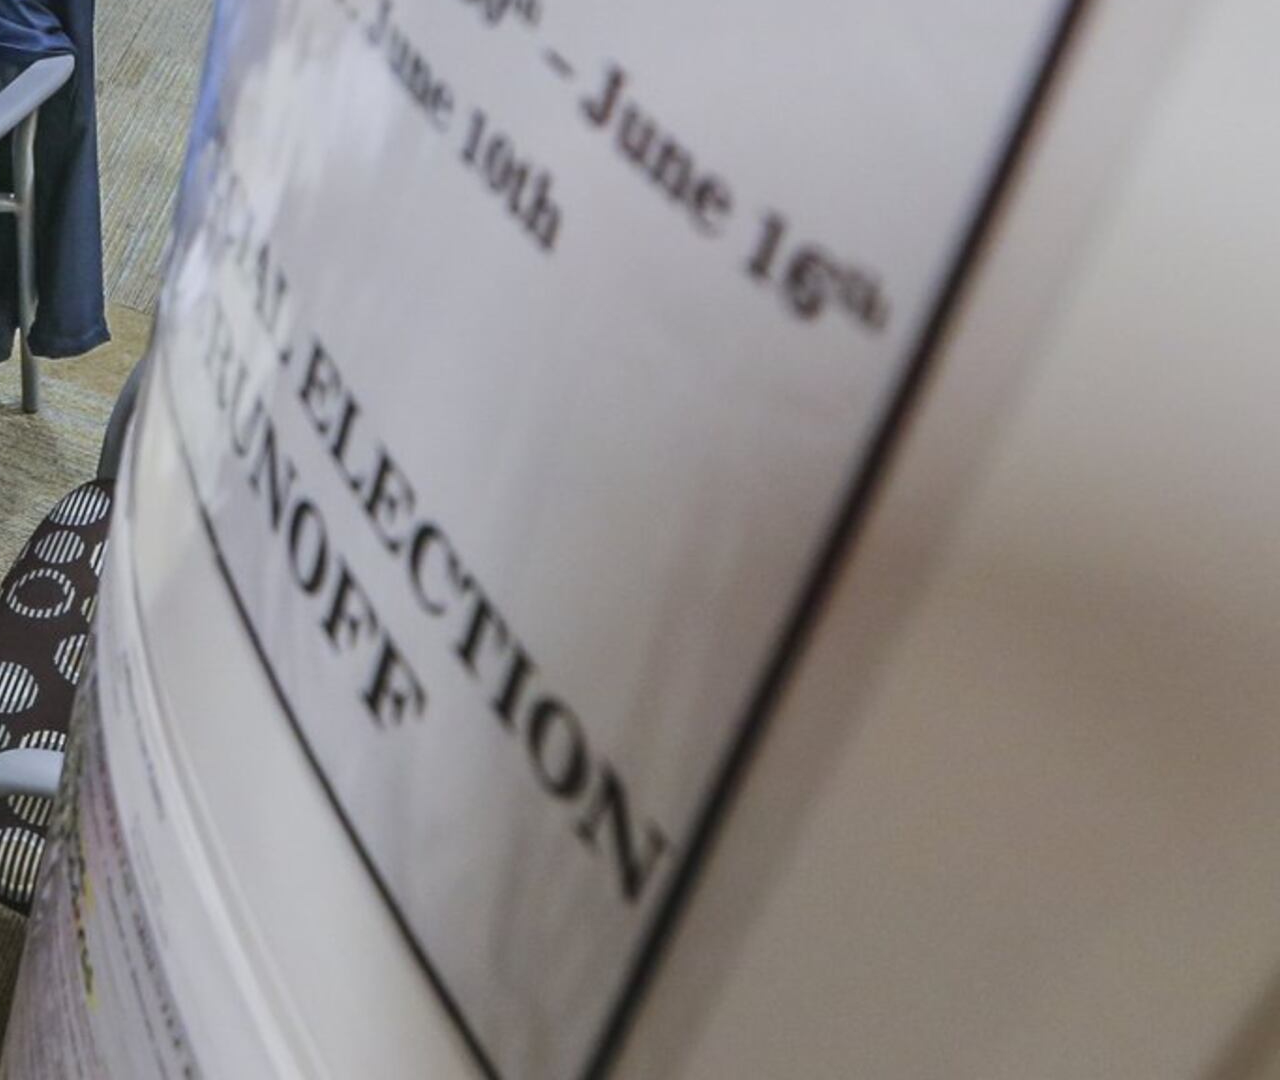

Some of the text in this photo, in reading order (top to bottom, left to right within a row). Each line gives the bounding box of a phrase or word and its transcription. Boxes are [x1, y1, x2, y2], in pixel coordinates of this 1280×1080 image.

[458, 107, 564, 255] 10th
[580, 60, 735, 238] June
[743, 212, 890, 332] 16th
[300, 332, 672, 905] ELECTION
